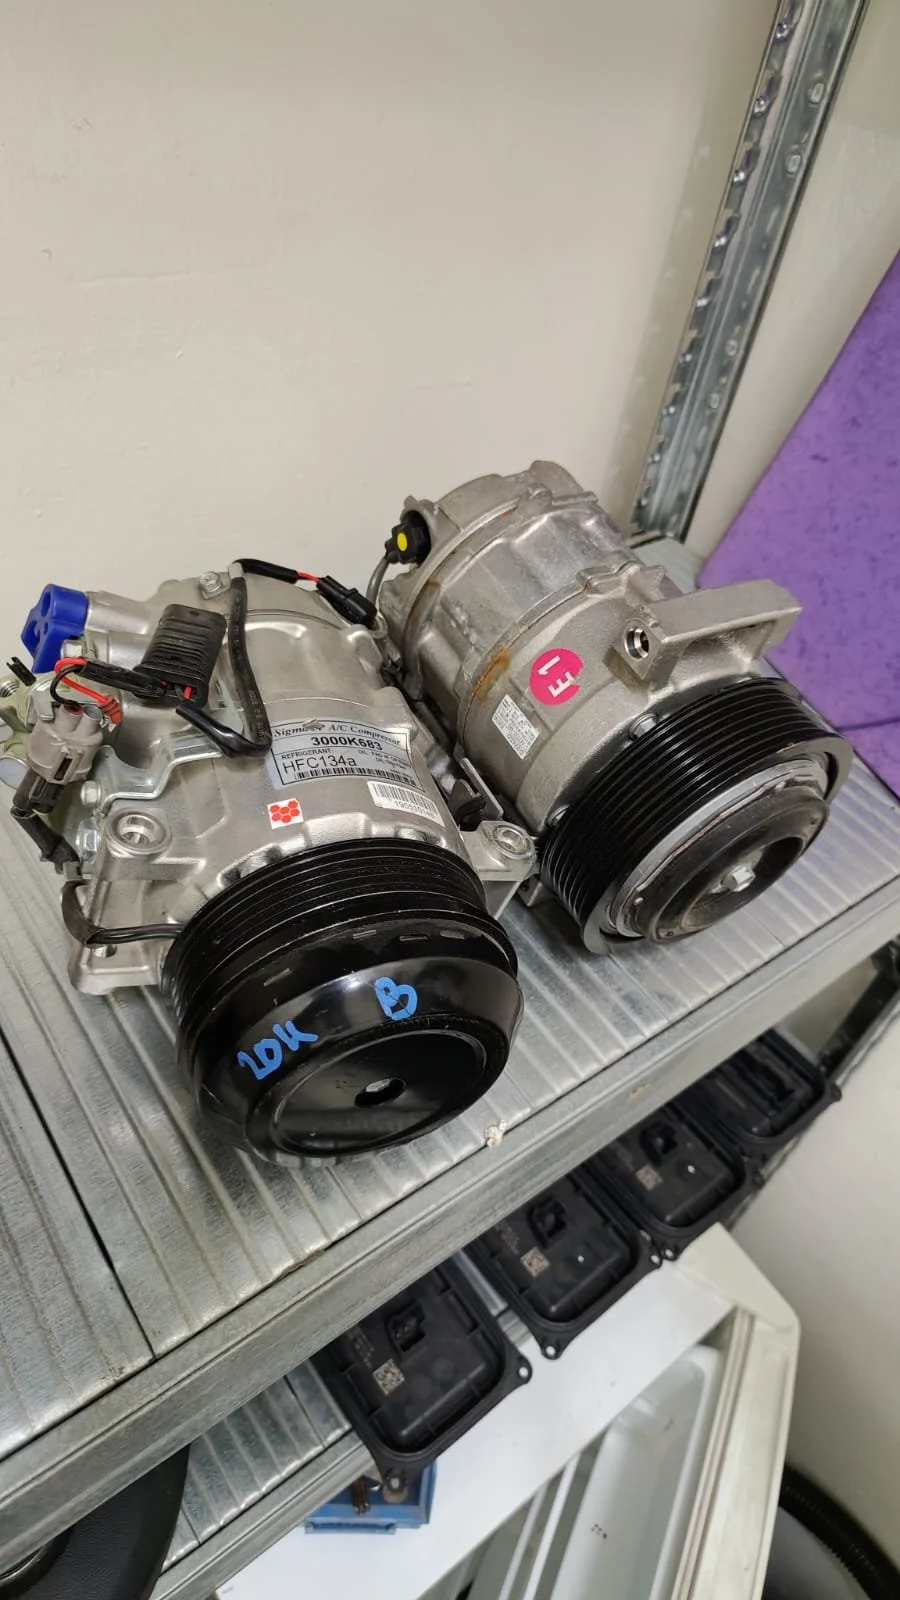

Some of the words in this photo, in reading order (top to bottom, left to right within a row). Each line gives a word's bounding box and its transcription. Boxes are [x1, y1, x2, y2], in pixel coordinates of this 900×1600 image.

[537, 655, 575, 697] E1
[311, 736, 383, 751] 3000K683
[328, 724, 348, 732] A/C
[350, 726, 401, 746] Compressor
[283, 755, 357, 773] HFC134a
